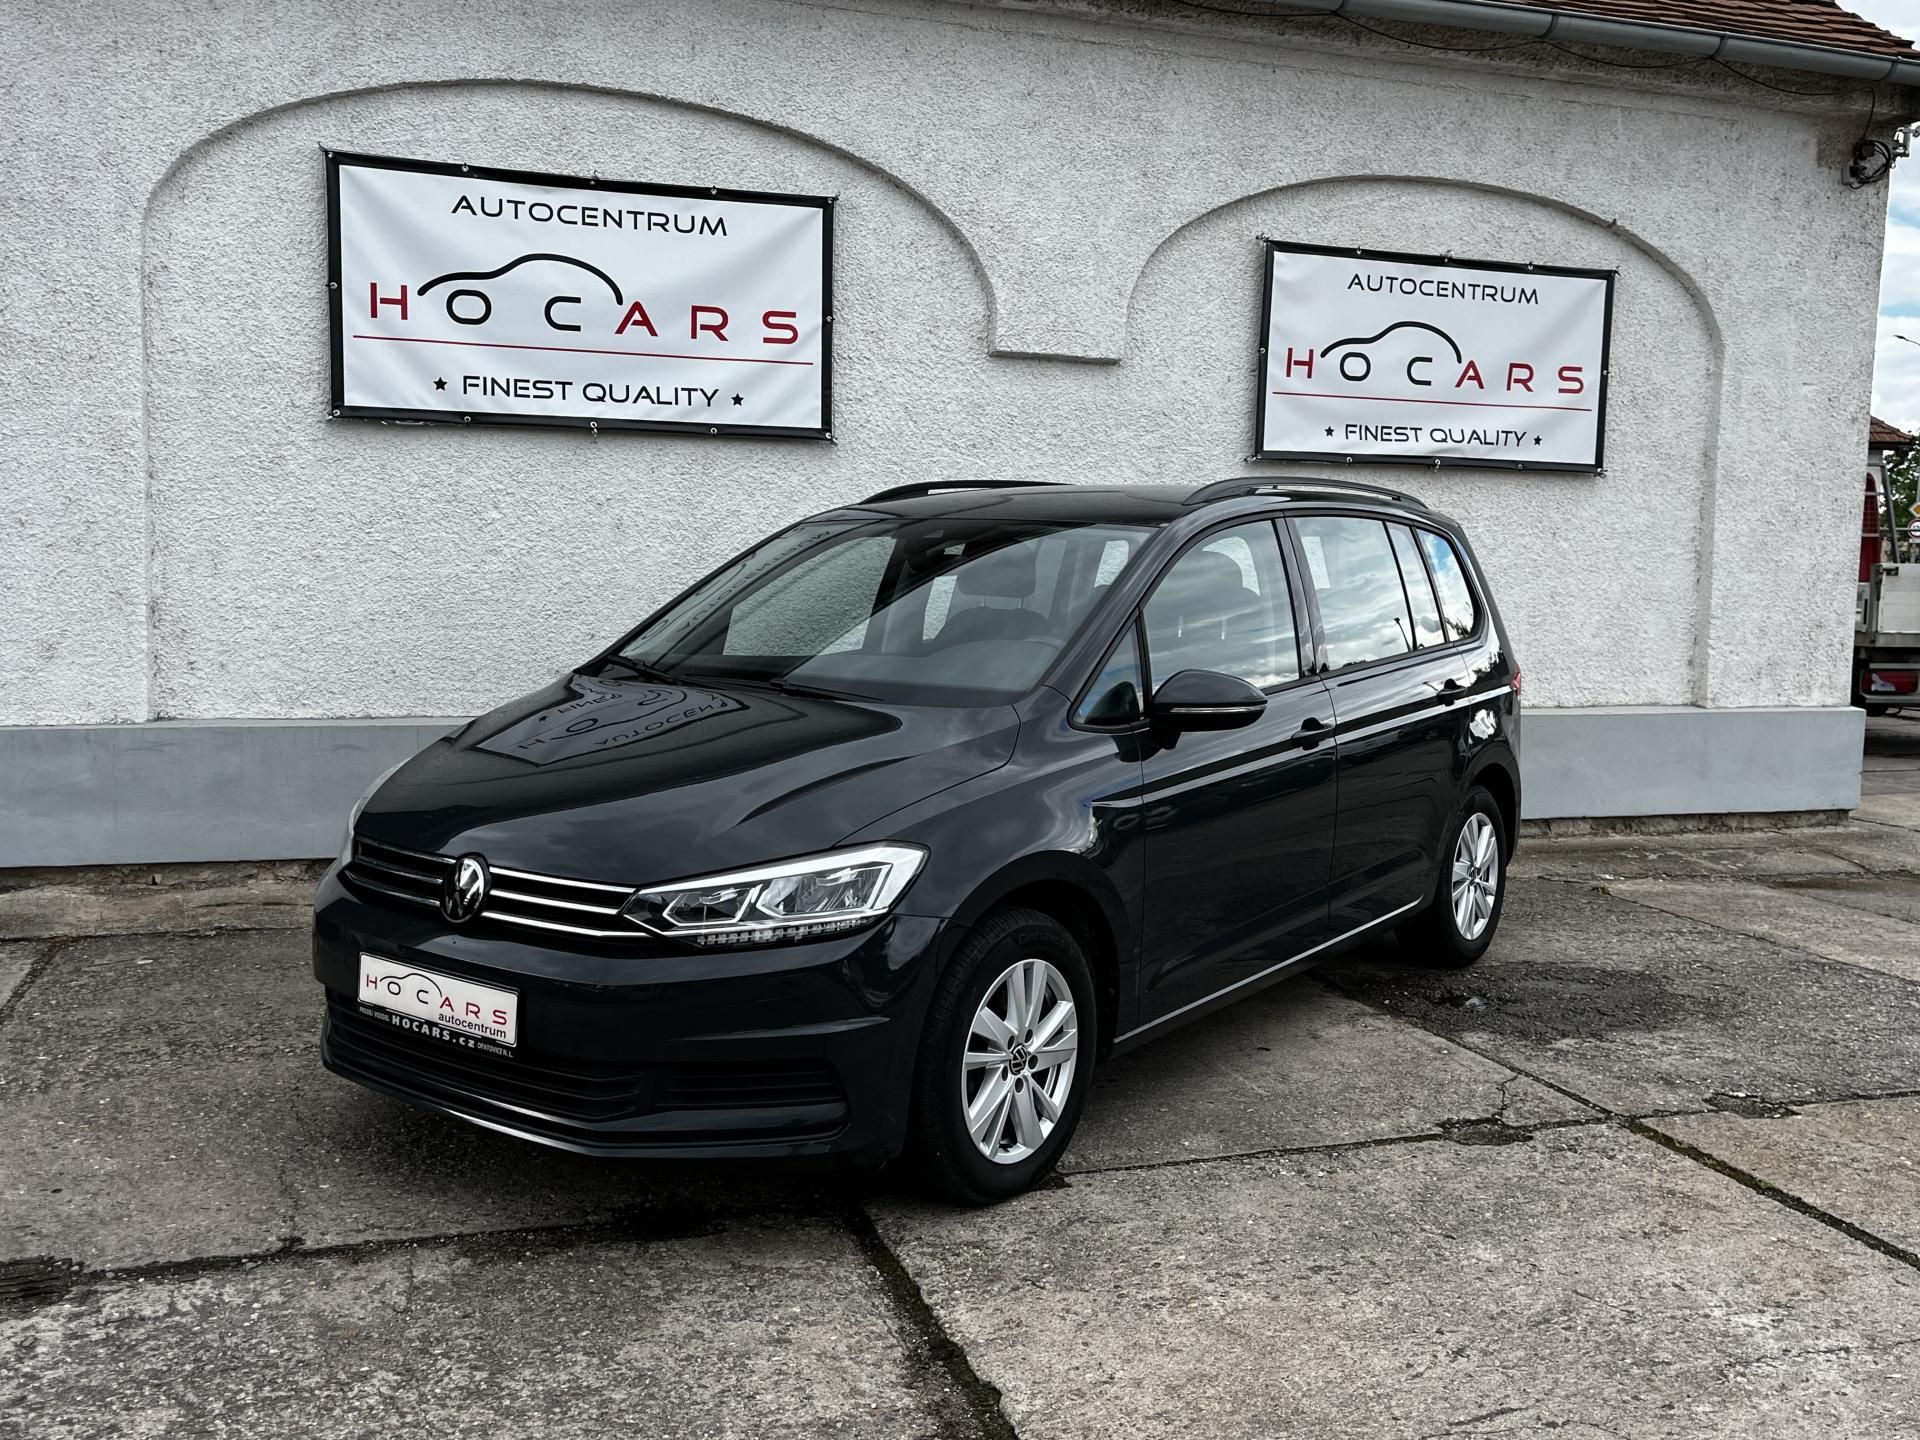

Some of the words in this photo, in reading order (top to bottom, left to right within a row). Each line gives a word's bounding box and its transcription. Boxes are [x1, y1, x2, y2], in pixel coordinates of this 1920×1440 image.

[450, 194, 728, 237] AUTOCENTRUM
[1347, 272, 1539, 305] AUTOCENTRUM
[462, 375, 573, 401] FINEST
[582, 382, 720, 408] QUALITY
[1345, 424, 1423, 443] FINEST
[1429, 428, 1527, 447] QUALITY
[438, 1012, 507, 1040] autocentrum
